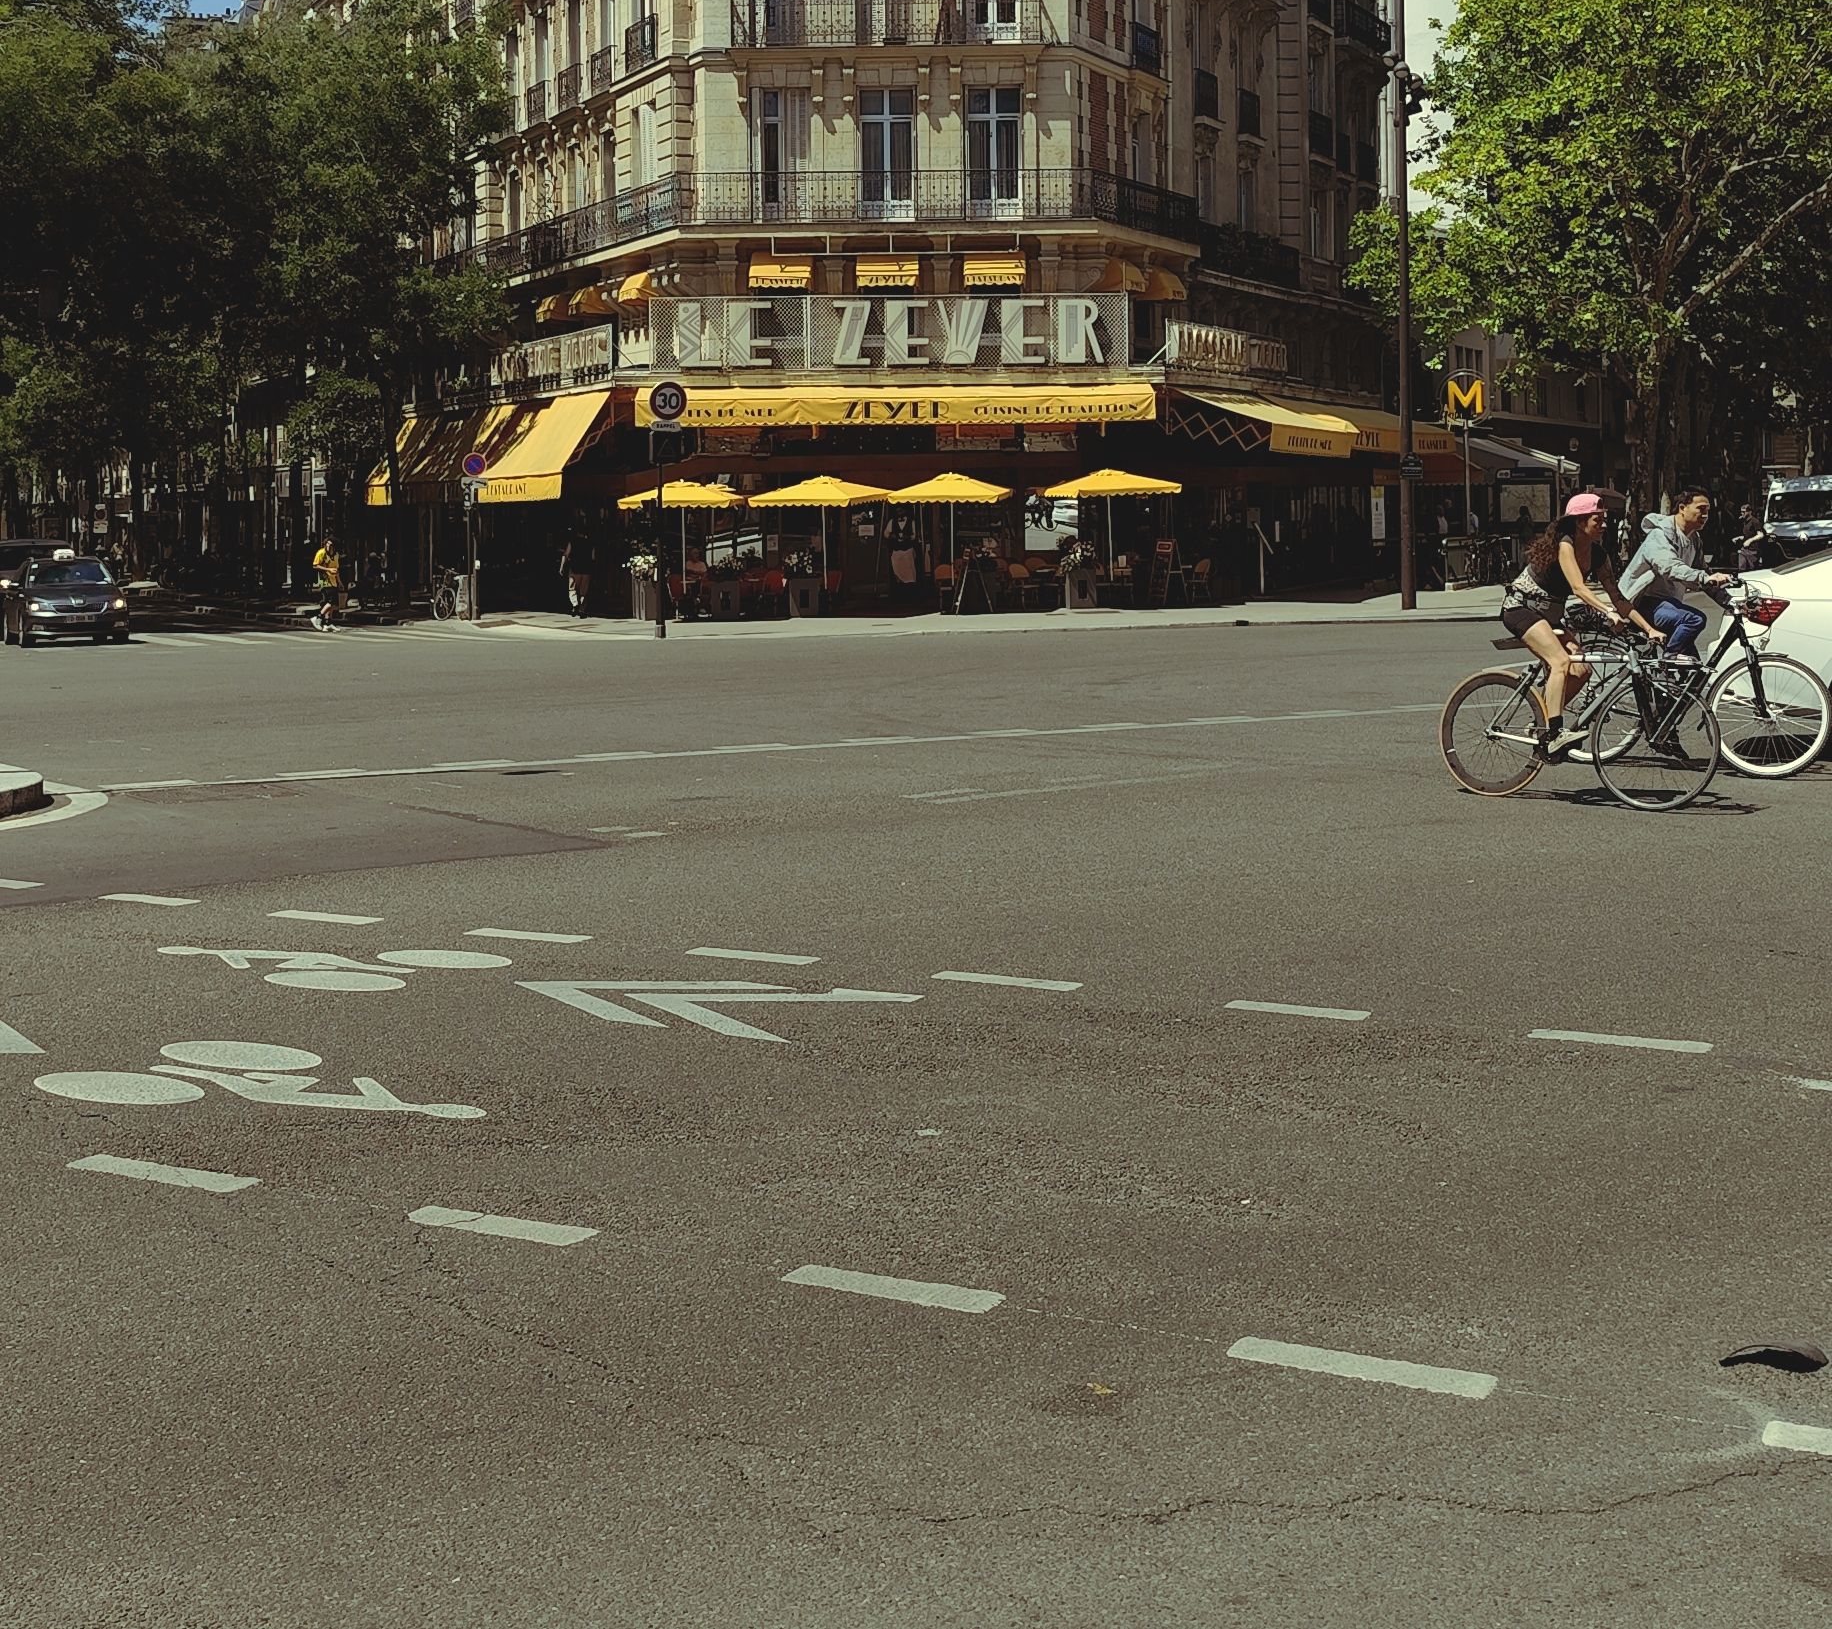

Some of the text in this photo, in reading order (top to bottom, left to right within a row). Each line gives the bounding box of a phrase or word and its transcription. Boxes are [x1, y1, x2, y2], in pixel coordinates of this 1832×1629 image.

[678, 301, 773, 367] LE
[657, 392, 680, 410] 30
[1447, 379, 1484, 414] M
[742, 407, 777, 418] MER
[841, 399, 949, 420] ZEYER
[973, 405, 1029, 415] CUISINE
[1059, 403, 1139, 414] TRADITION
